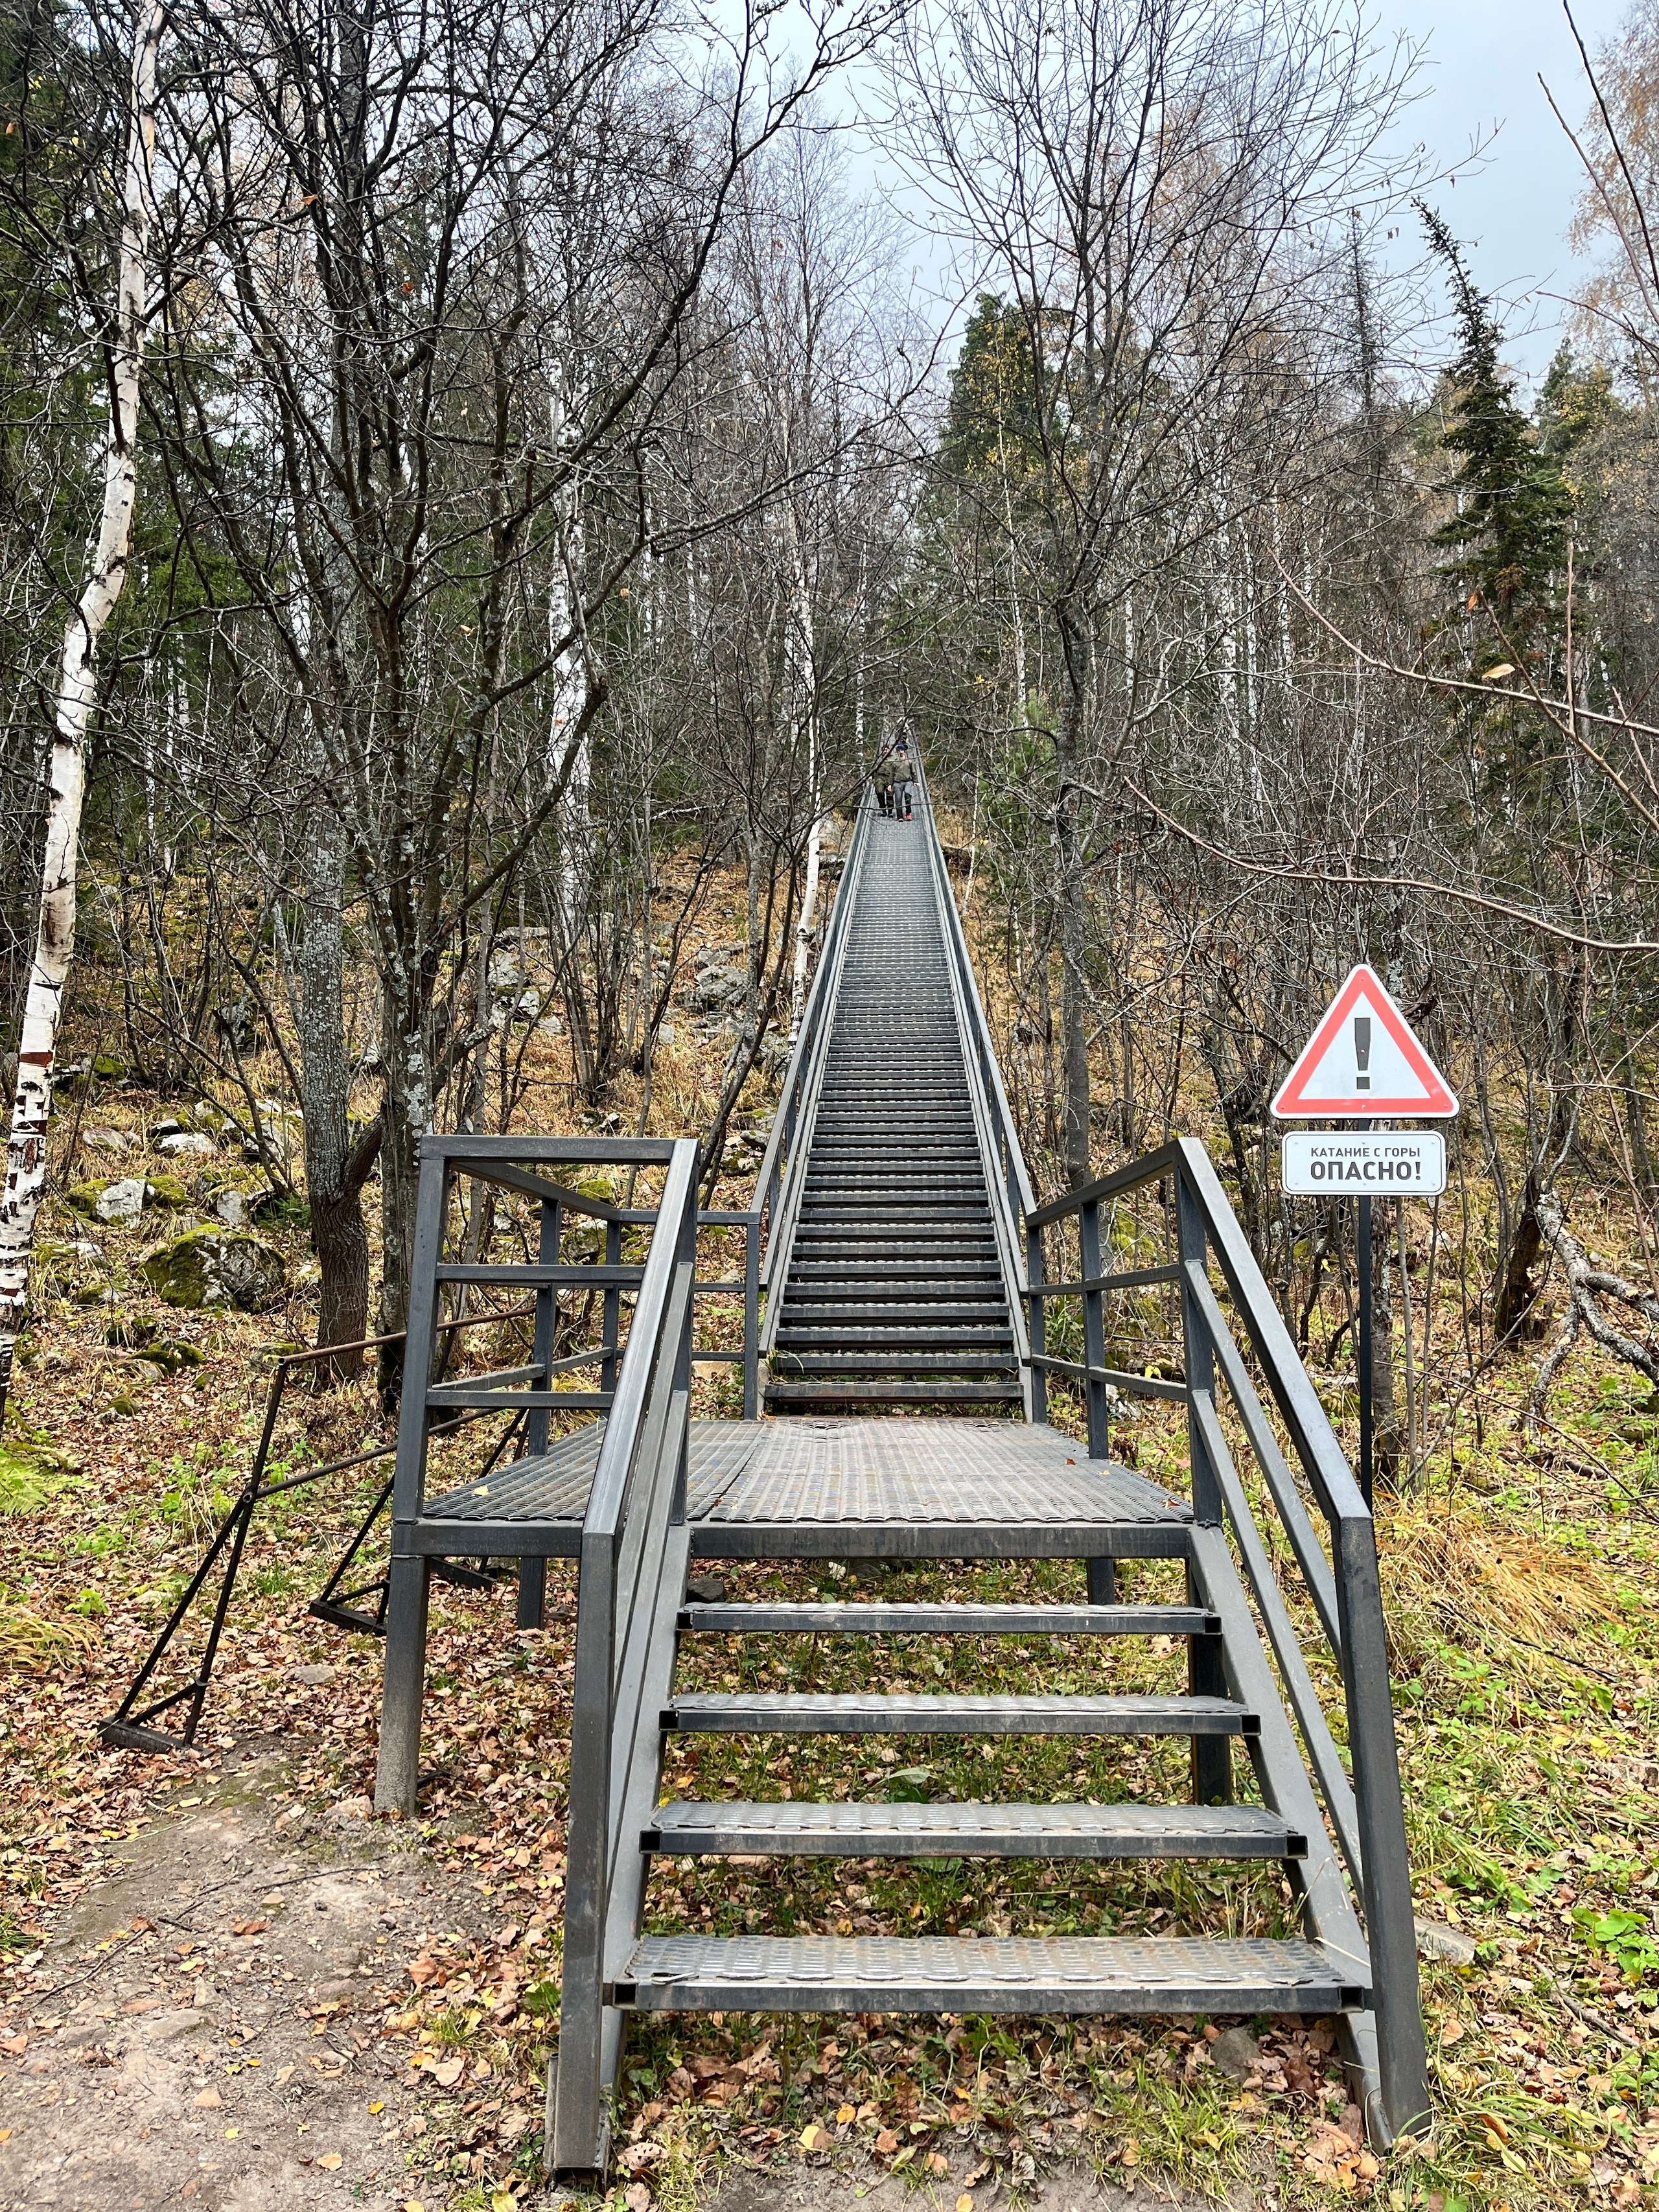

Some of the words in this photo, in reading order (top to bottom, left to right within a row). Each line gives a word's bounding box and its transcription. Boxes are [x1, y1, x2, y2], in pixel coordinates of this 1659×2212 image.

[1310, 1147, 1370, 1157] КАТАНИЕ
[1373, 1147, 1381, 1157] С
[1384, 1147, 1421, 1157] ГОРЫ
[1310, 1161, 1421, 1180] ОПАСНО!
